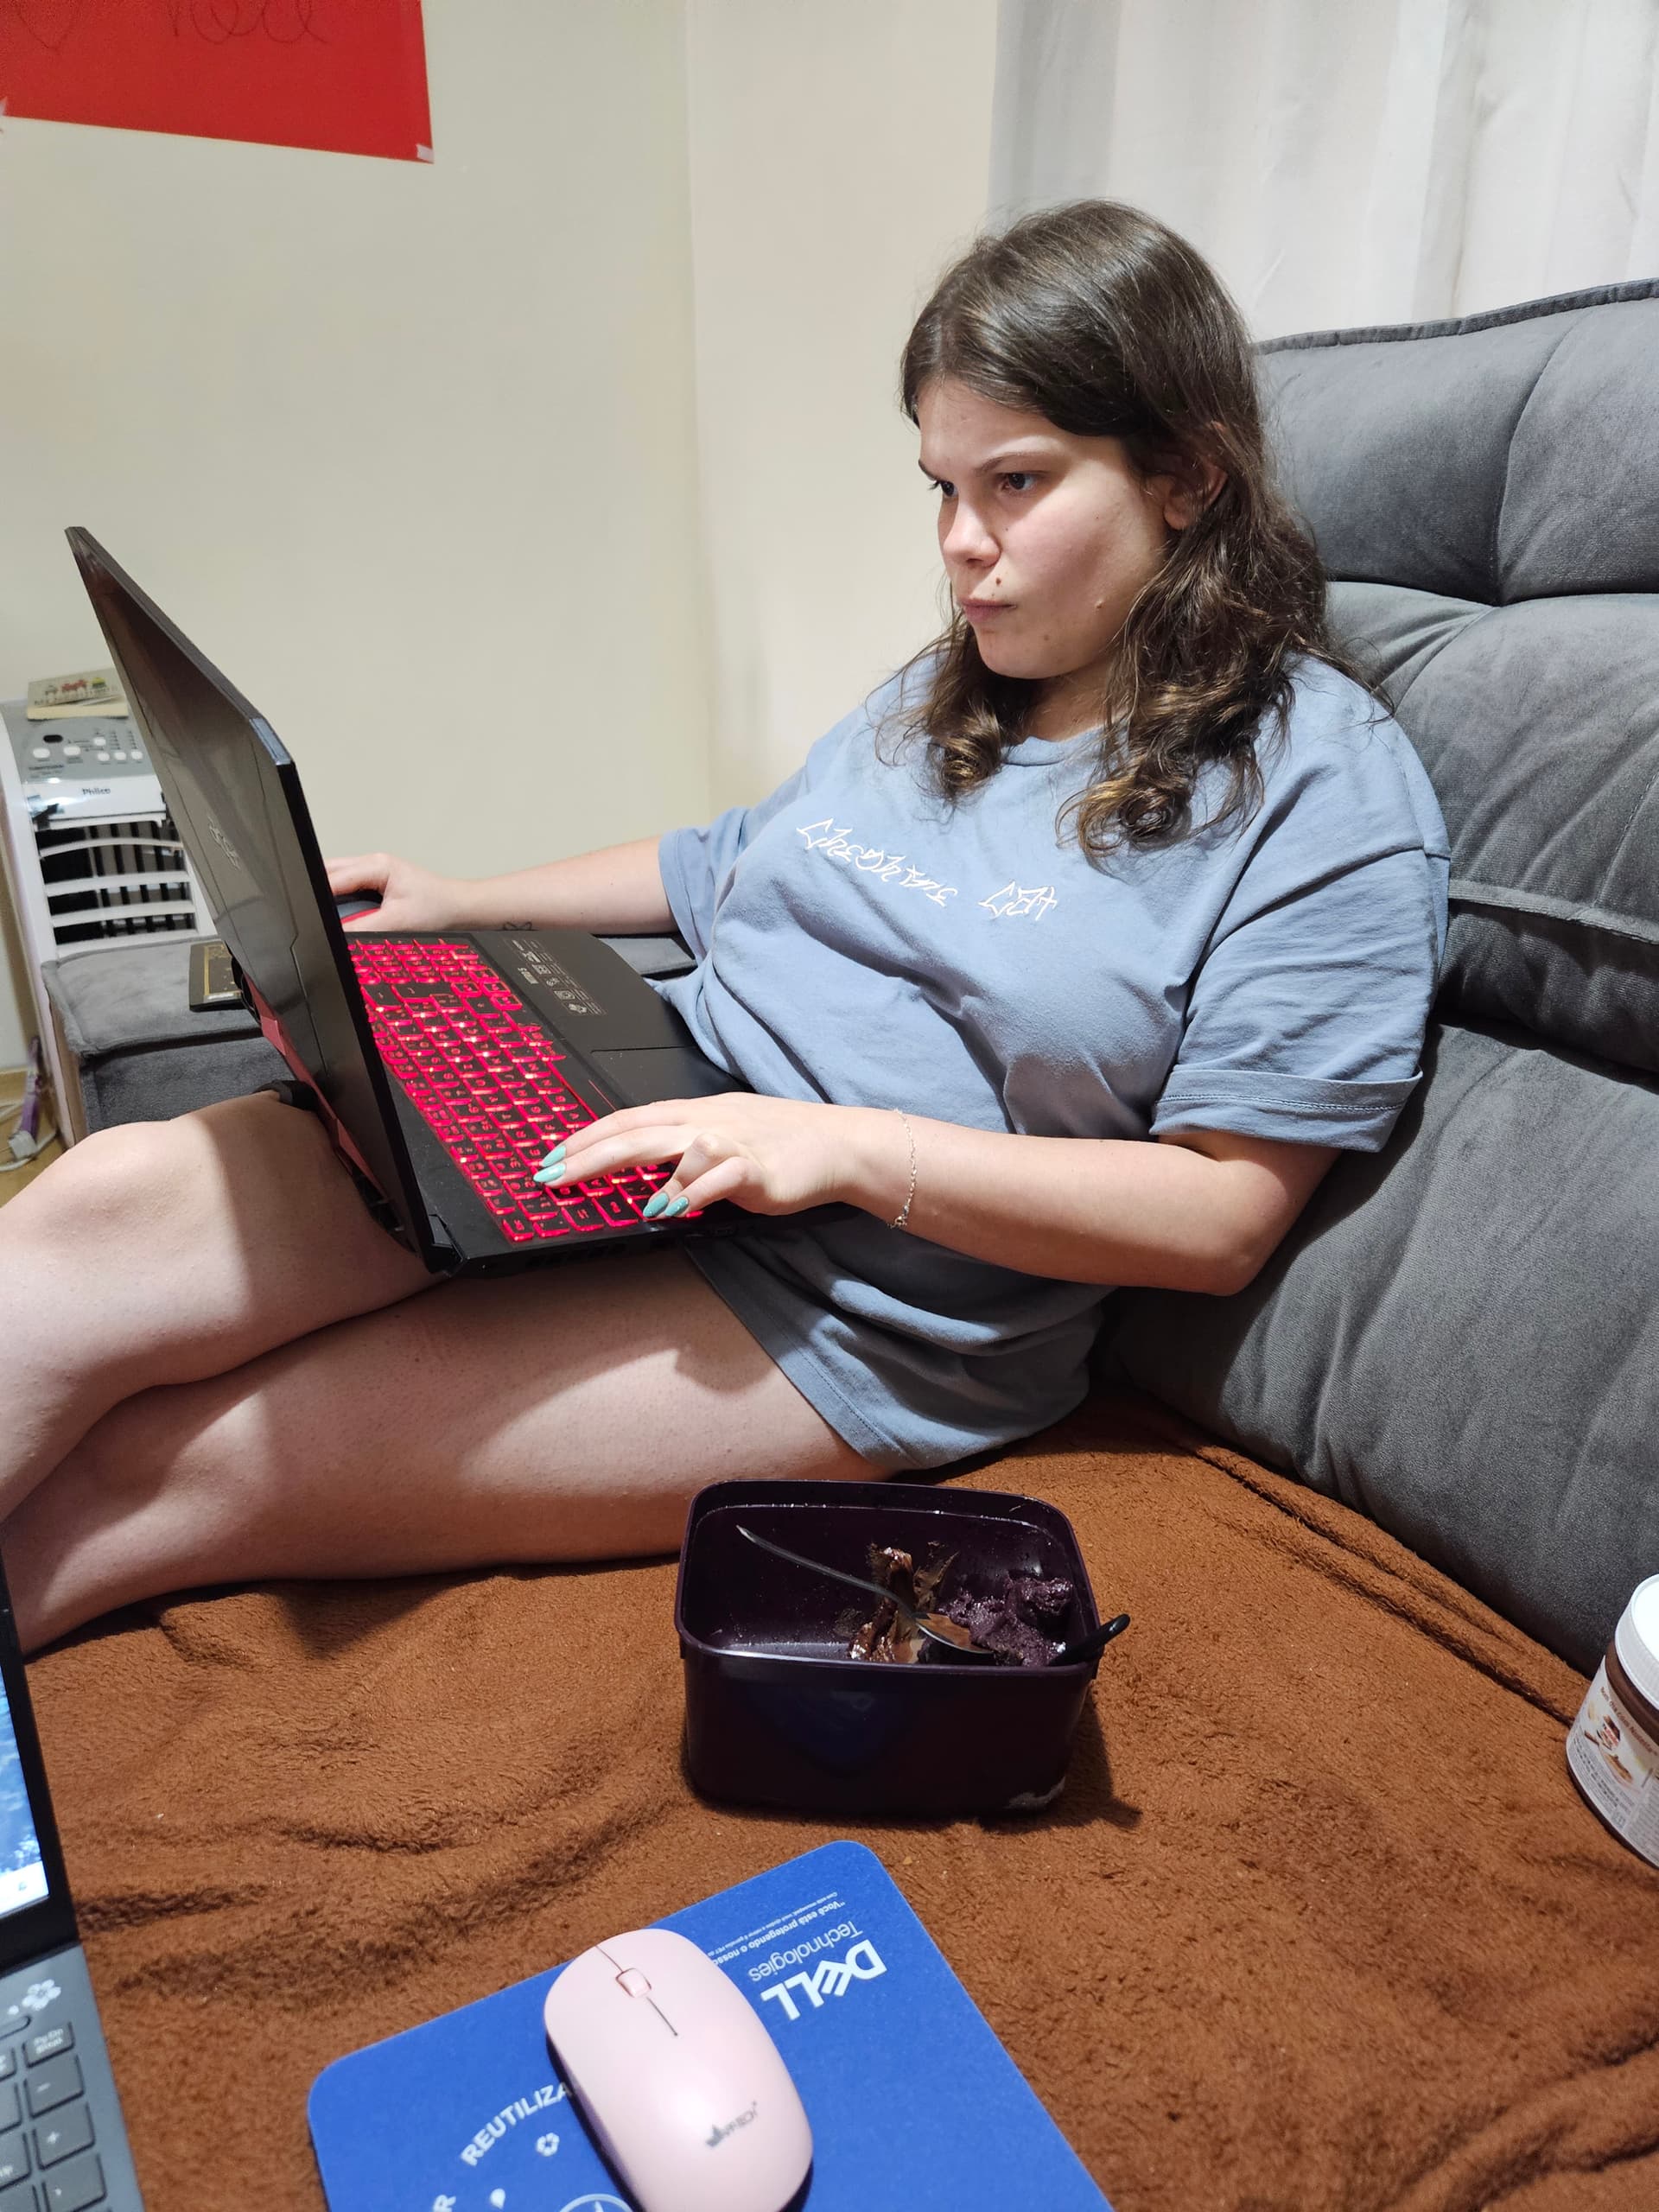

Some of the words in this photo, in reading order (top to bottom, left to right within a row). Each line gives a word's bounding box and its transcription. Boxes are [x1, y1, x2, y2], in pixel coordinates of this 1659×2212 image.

[748, 1917, 799, 1949] protegendo
[748, 1920, 863, 1982] Technologies
[760, 1939, 888, 2020] DELL
